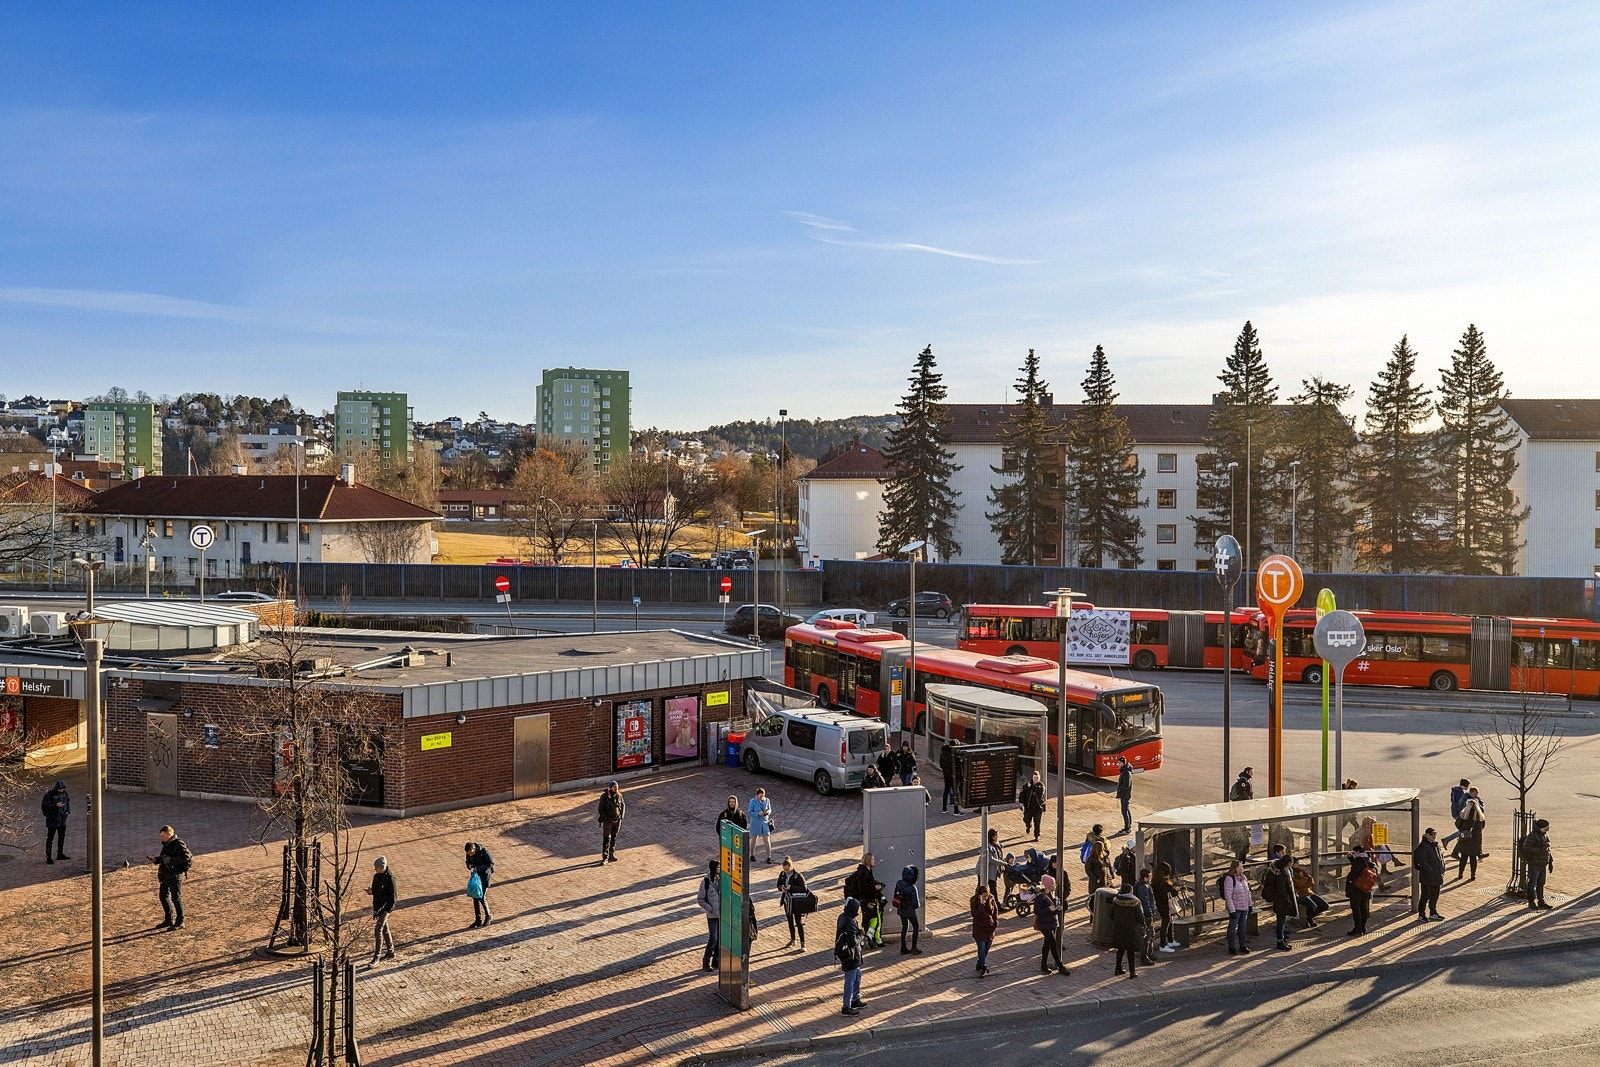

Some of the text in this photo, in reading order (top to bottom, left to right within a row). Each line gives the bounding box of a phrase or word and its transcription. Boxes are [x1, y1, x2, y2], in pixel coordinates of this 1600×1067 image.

[197, 532, 207, 544] T
[1267, 570, 1284, 598] T
[1385, 645, 1402, 653] Oslo
[22, 681, 51, 694] Helsfyr
